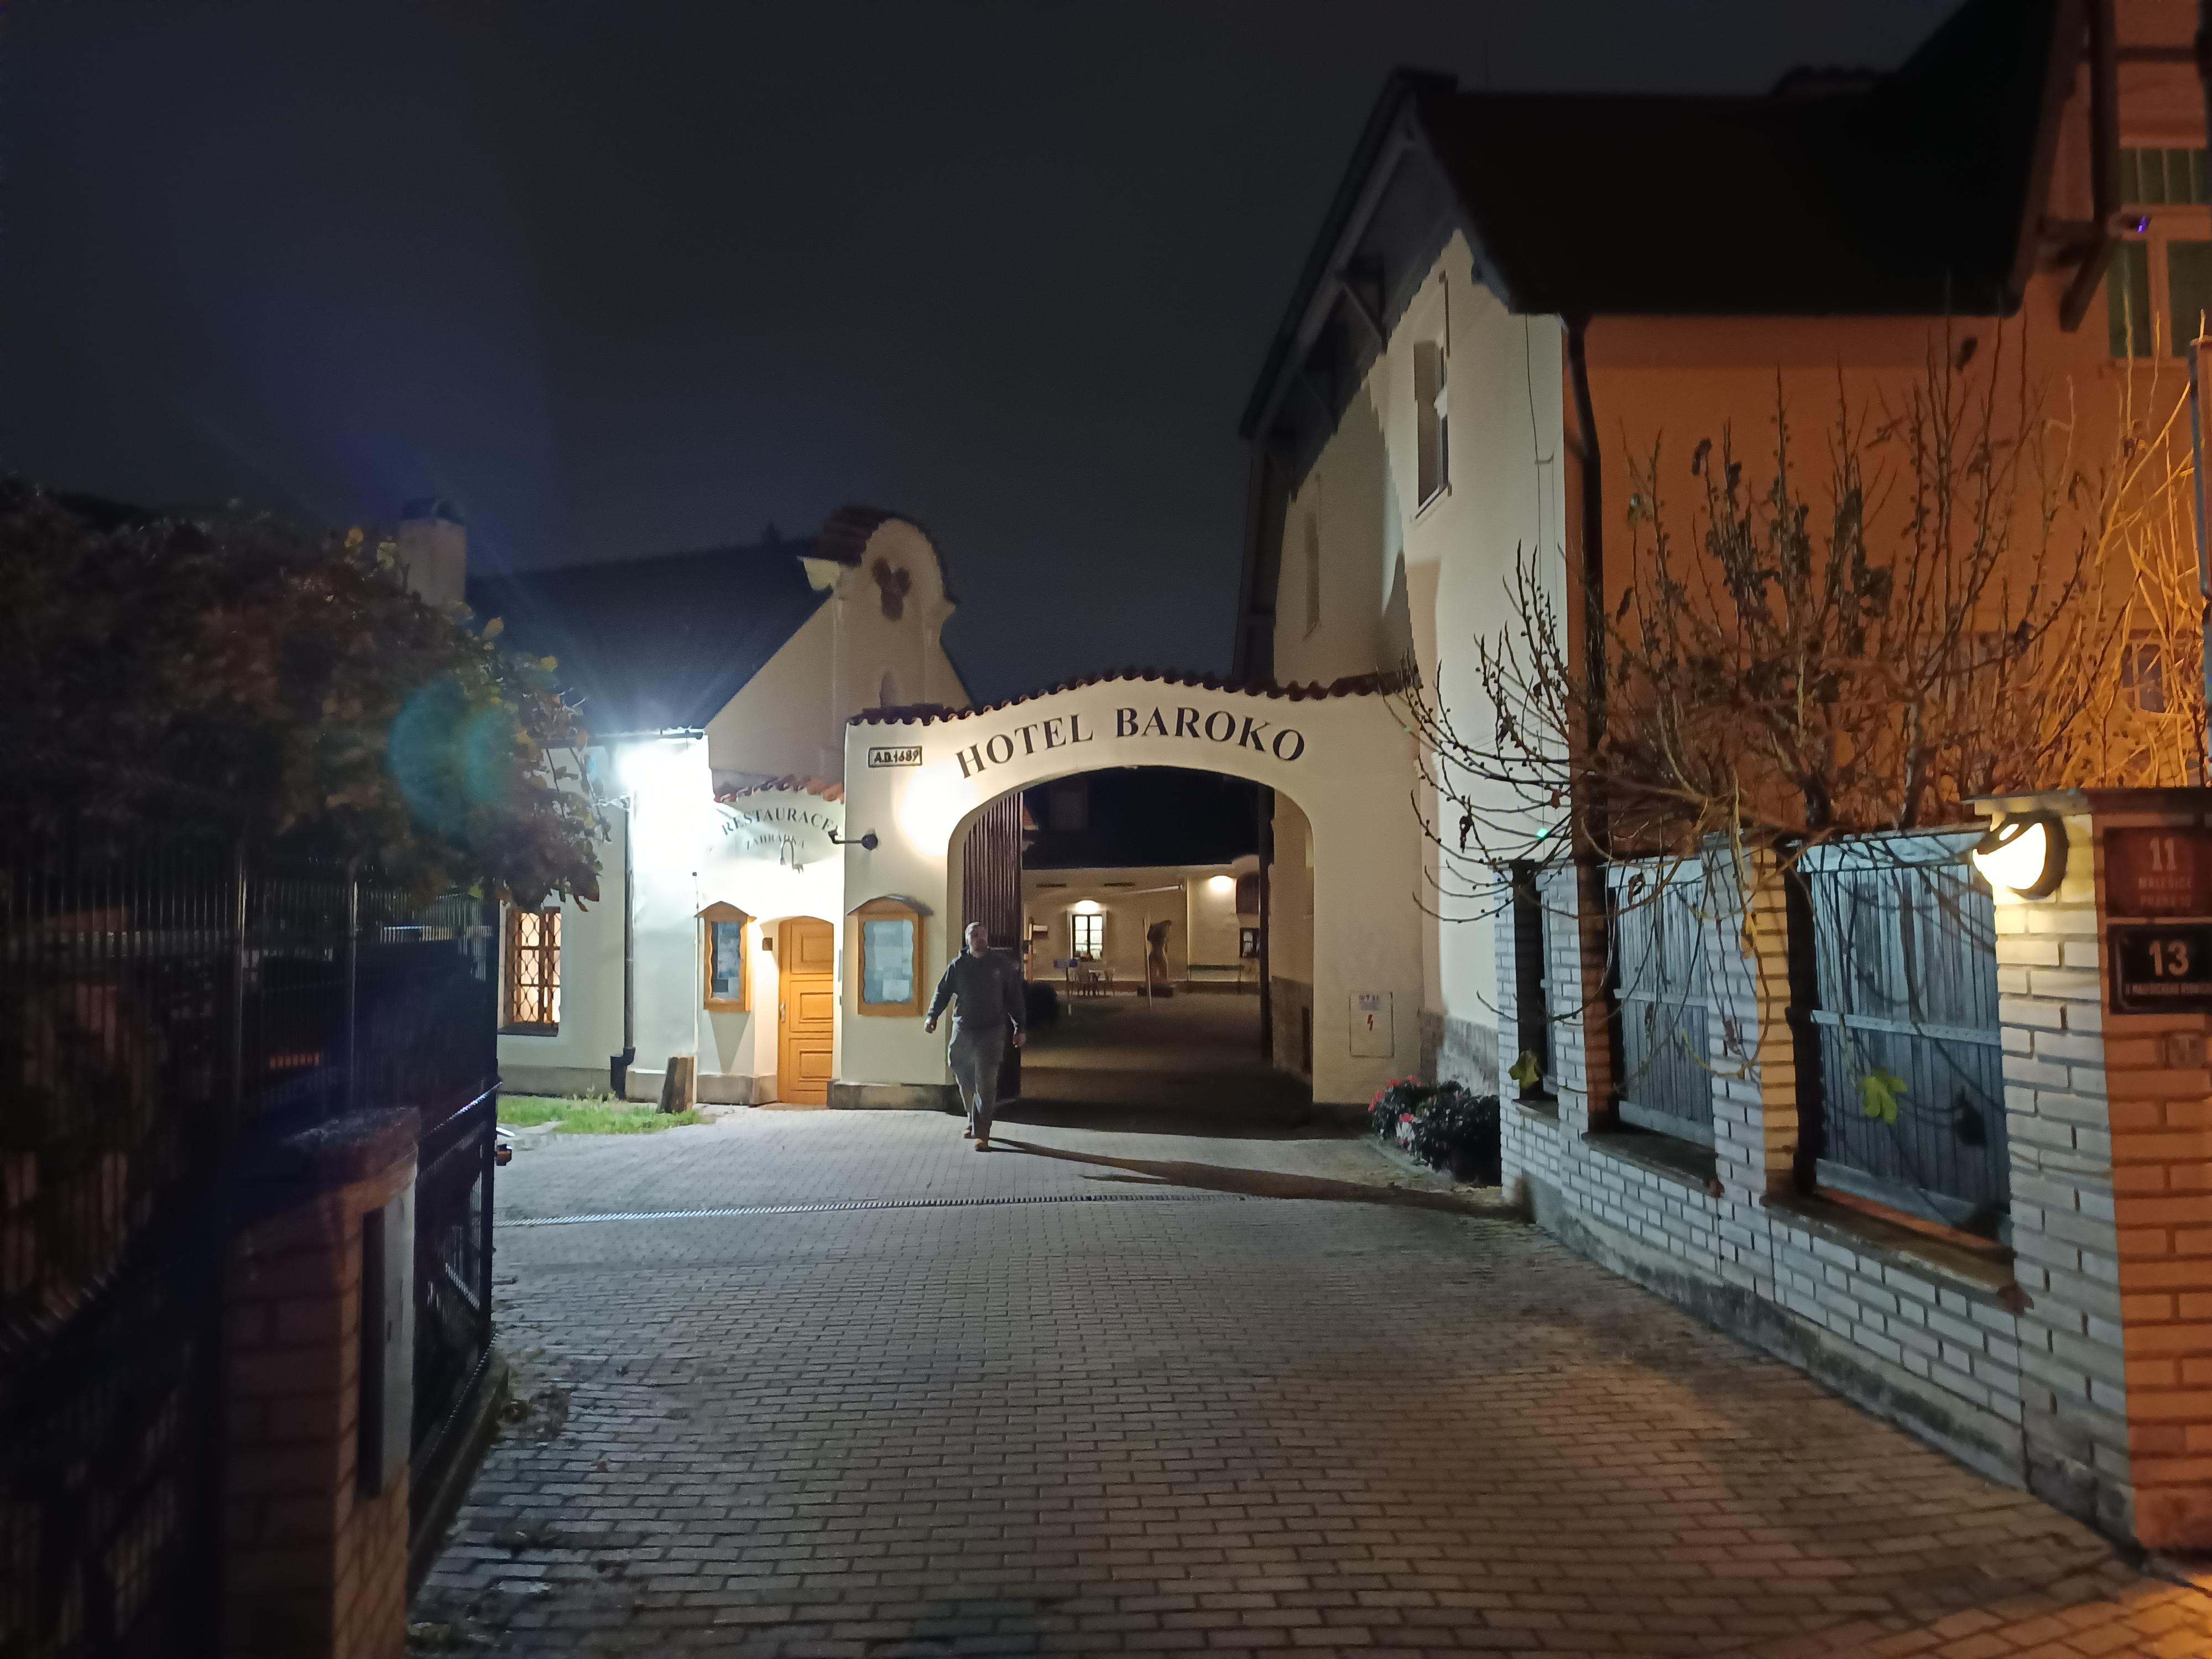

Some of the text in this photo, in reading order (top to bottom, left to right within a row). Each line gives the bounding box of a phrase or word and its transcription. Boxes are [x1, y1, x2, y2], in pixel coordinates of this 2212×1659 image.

[955, 706, 1306, 779] HOTEL BAROKO
[2149, 837, 2176, 872] 11
[2148, 941, 2189, 977] 13
